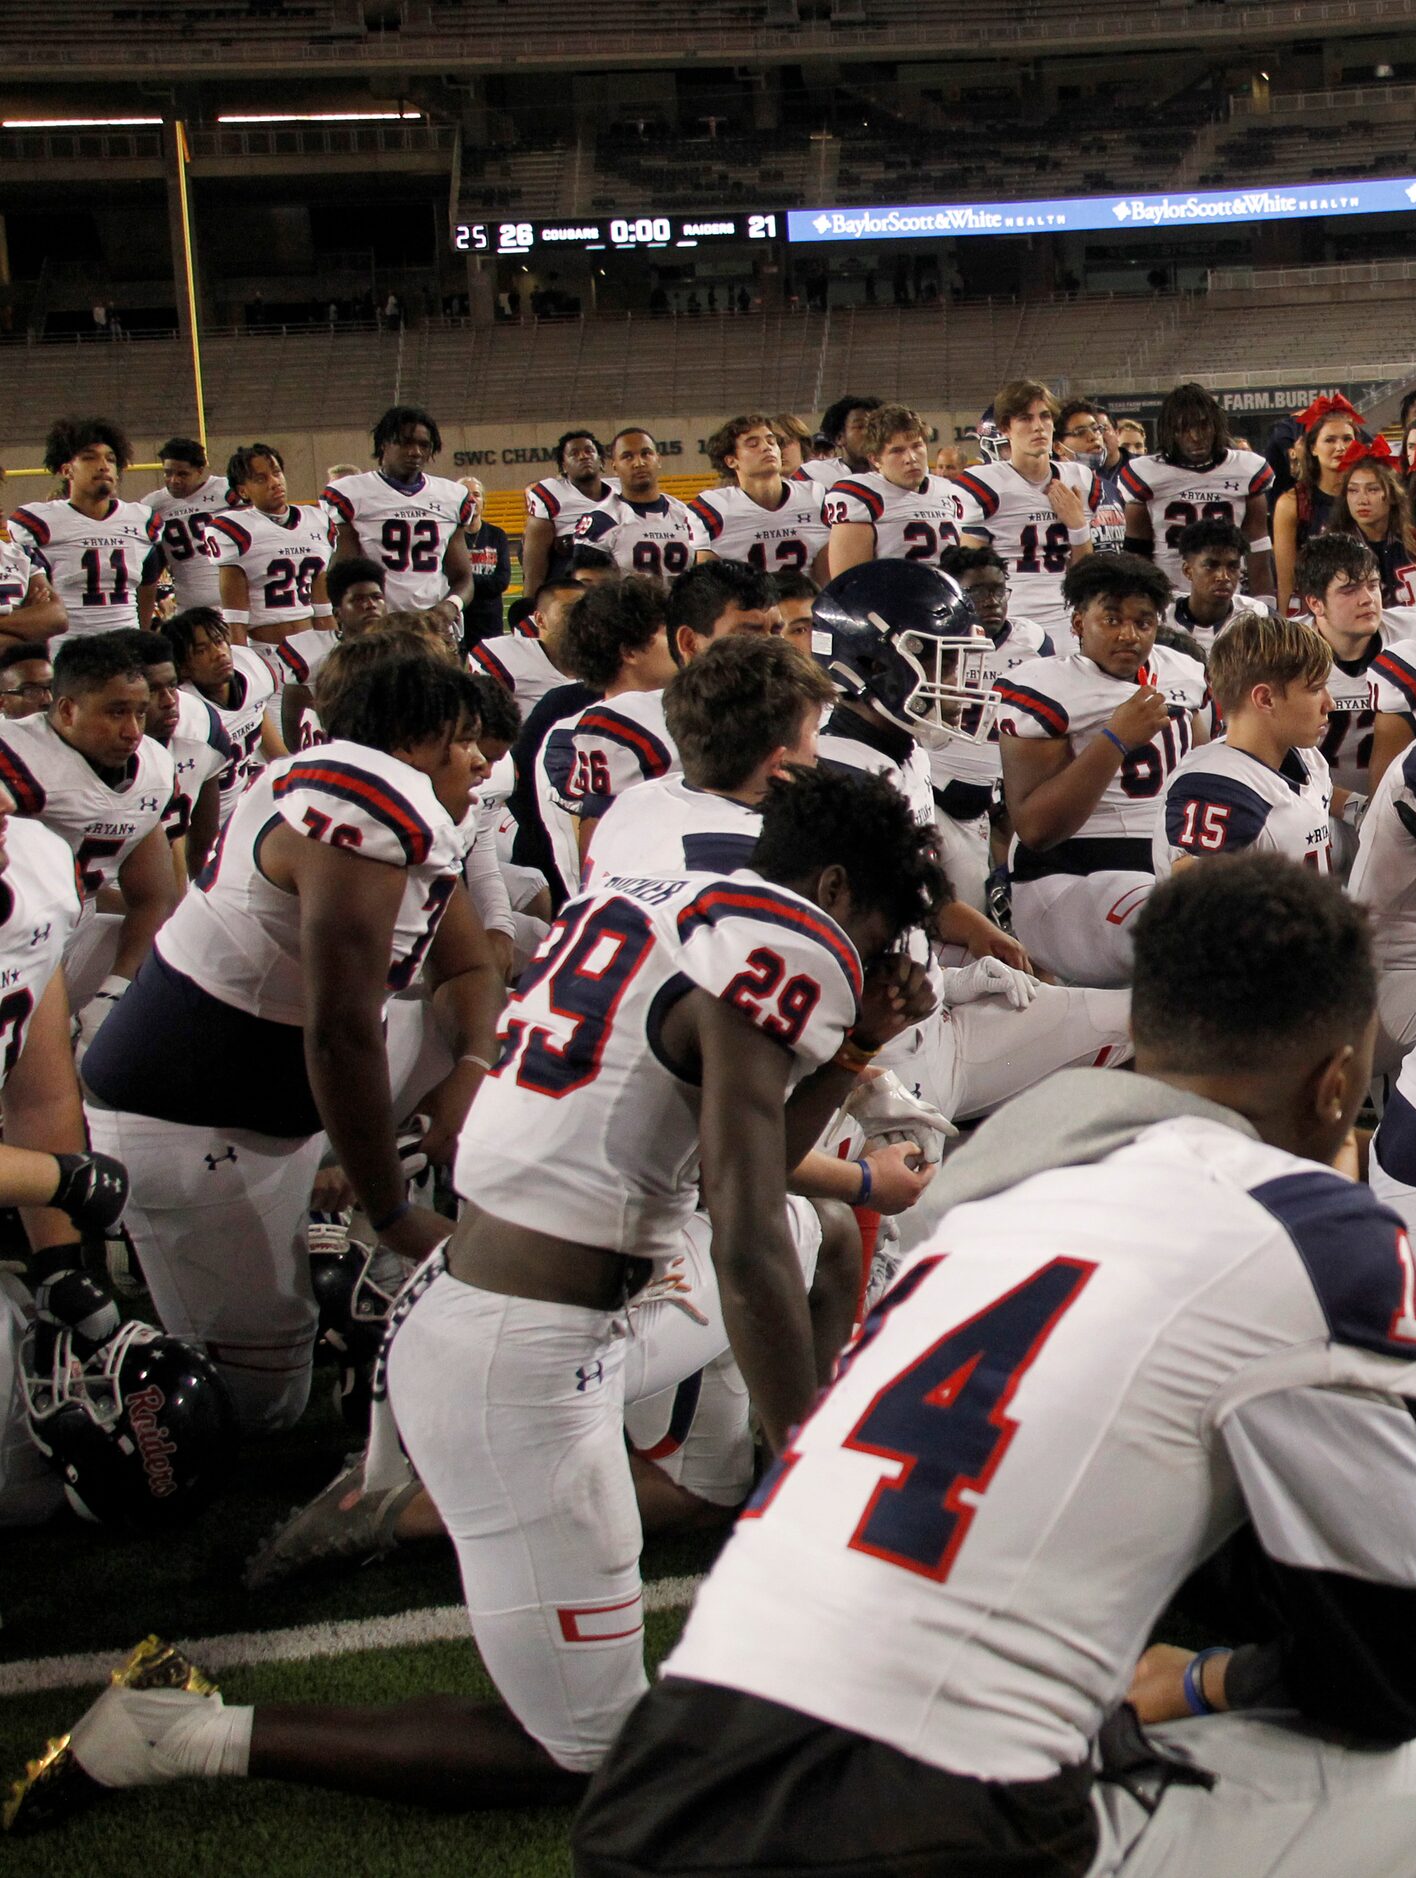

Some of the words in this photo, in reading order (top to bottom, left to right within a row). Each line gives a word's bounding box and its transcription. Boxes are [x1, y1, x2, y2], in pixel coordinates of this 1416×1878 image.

[1131, 193, 1296, 223] BaylorScott&White
[1299, 197, 1359, 209] HEALTH
[610, 217, 671, 243] 0:00
[682, 222, 735, 236] RAIDERS
[748, 214, 776, 239] 21
[832, 210, 1001, 237] BaylorScott&White
[1005, 214, 1066, 227] HEALTH
[456, 225, 487, 248] 25
[499, 223, 533, 246] 26
[454, 450, 497, 467] SWC
[1188, 491, 1213, 501] RYAN
[174, 508, 195, 517] RYAN
[400, 509, 420, 518] RYAN
[919, 511, 942, 519] RYAN
[1036, 511, 1058, 521] RYAN
[650, 531, 670, 539] RYAN
[762, 529, 790, 539] RYAN
[90, 538, 118, 547] RYAN
[381, 518, 440, 572] 92
[284, 547, 306, 555] RYAN
[81, 548, 129, 606] 11
[1336, 699, 1369, 710] RYAN
[92, 823, 129, 835] RYAN
[1179, 799, 1232, 853] 15
[719, 946, 821, 1046] 29
[124, 1384, 178, 1498] Raiders
